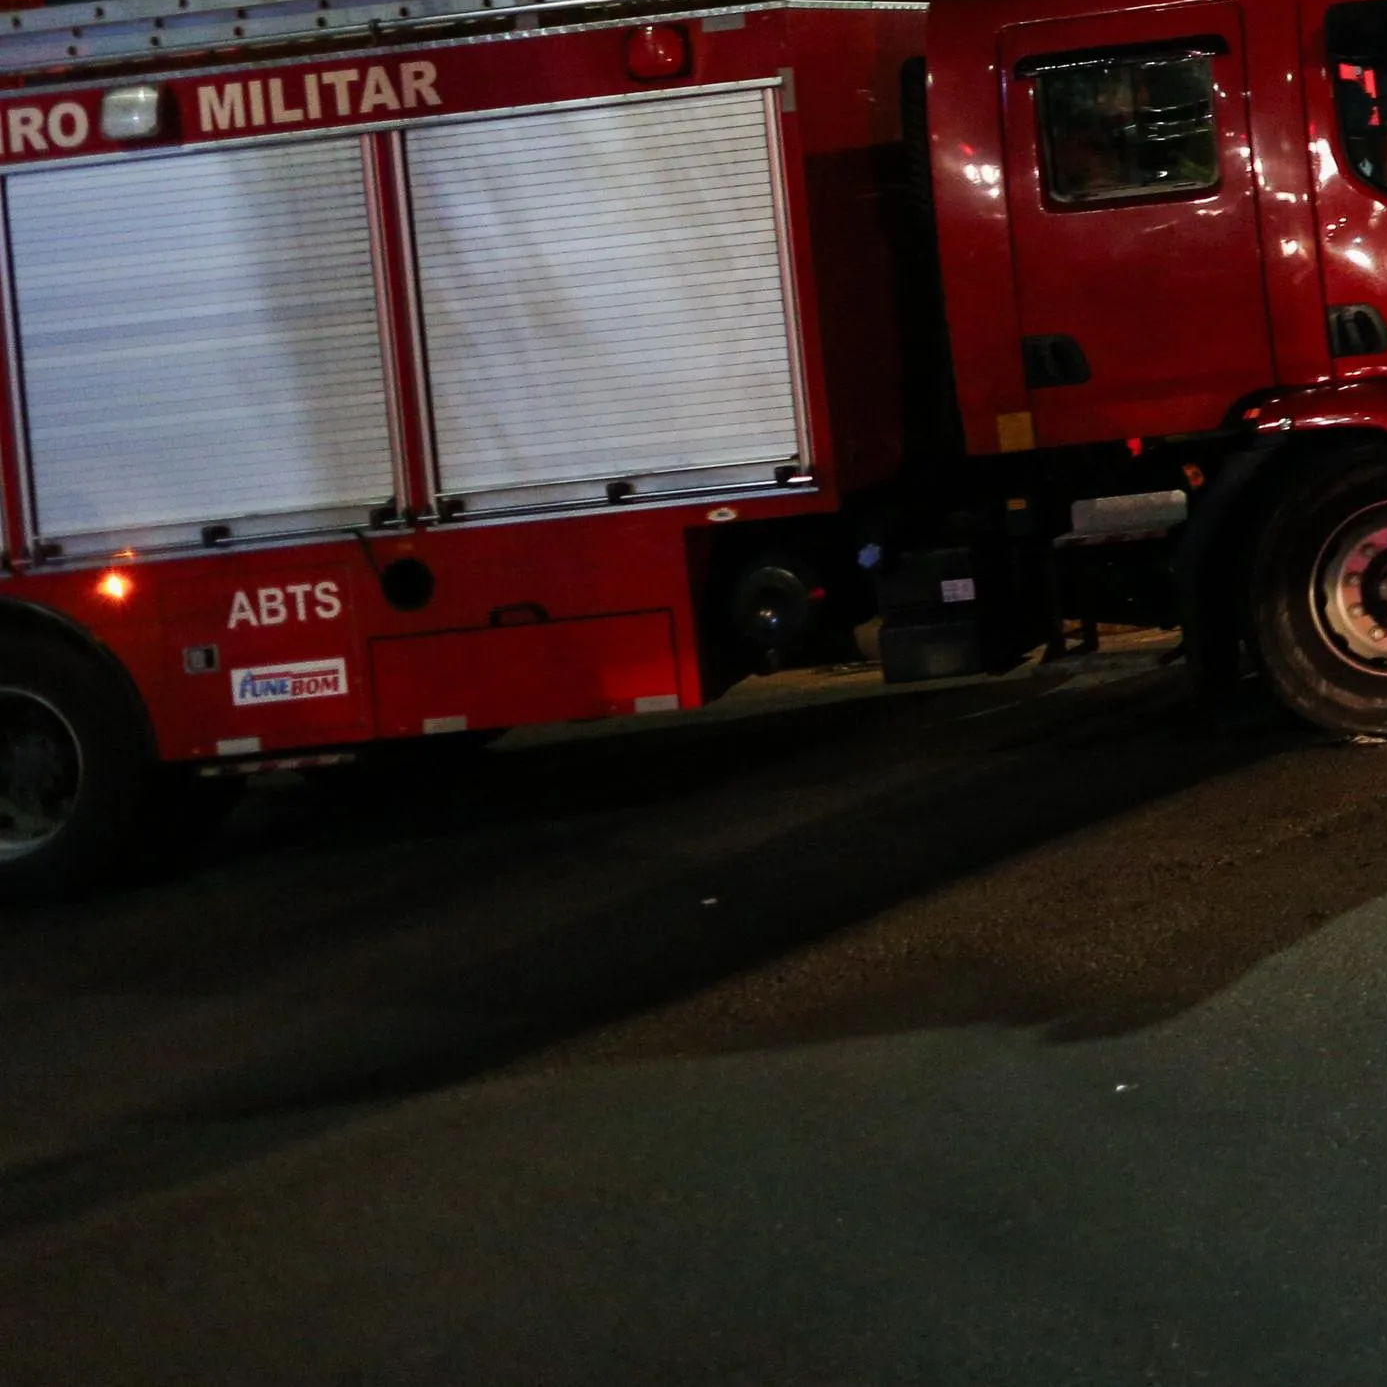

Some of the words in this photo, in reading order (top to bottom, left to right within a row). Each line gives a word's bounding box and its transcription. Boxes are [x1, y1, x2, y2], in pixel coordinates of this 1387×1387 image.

[0, 102, 90, 156] RO
[198, 60, 444, 133] MILITAR
[227, 581, 342, 630] ABTS
